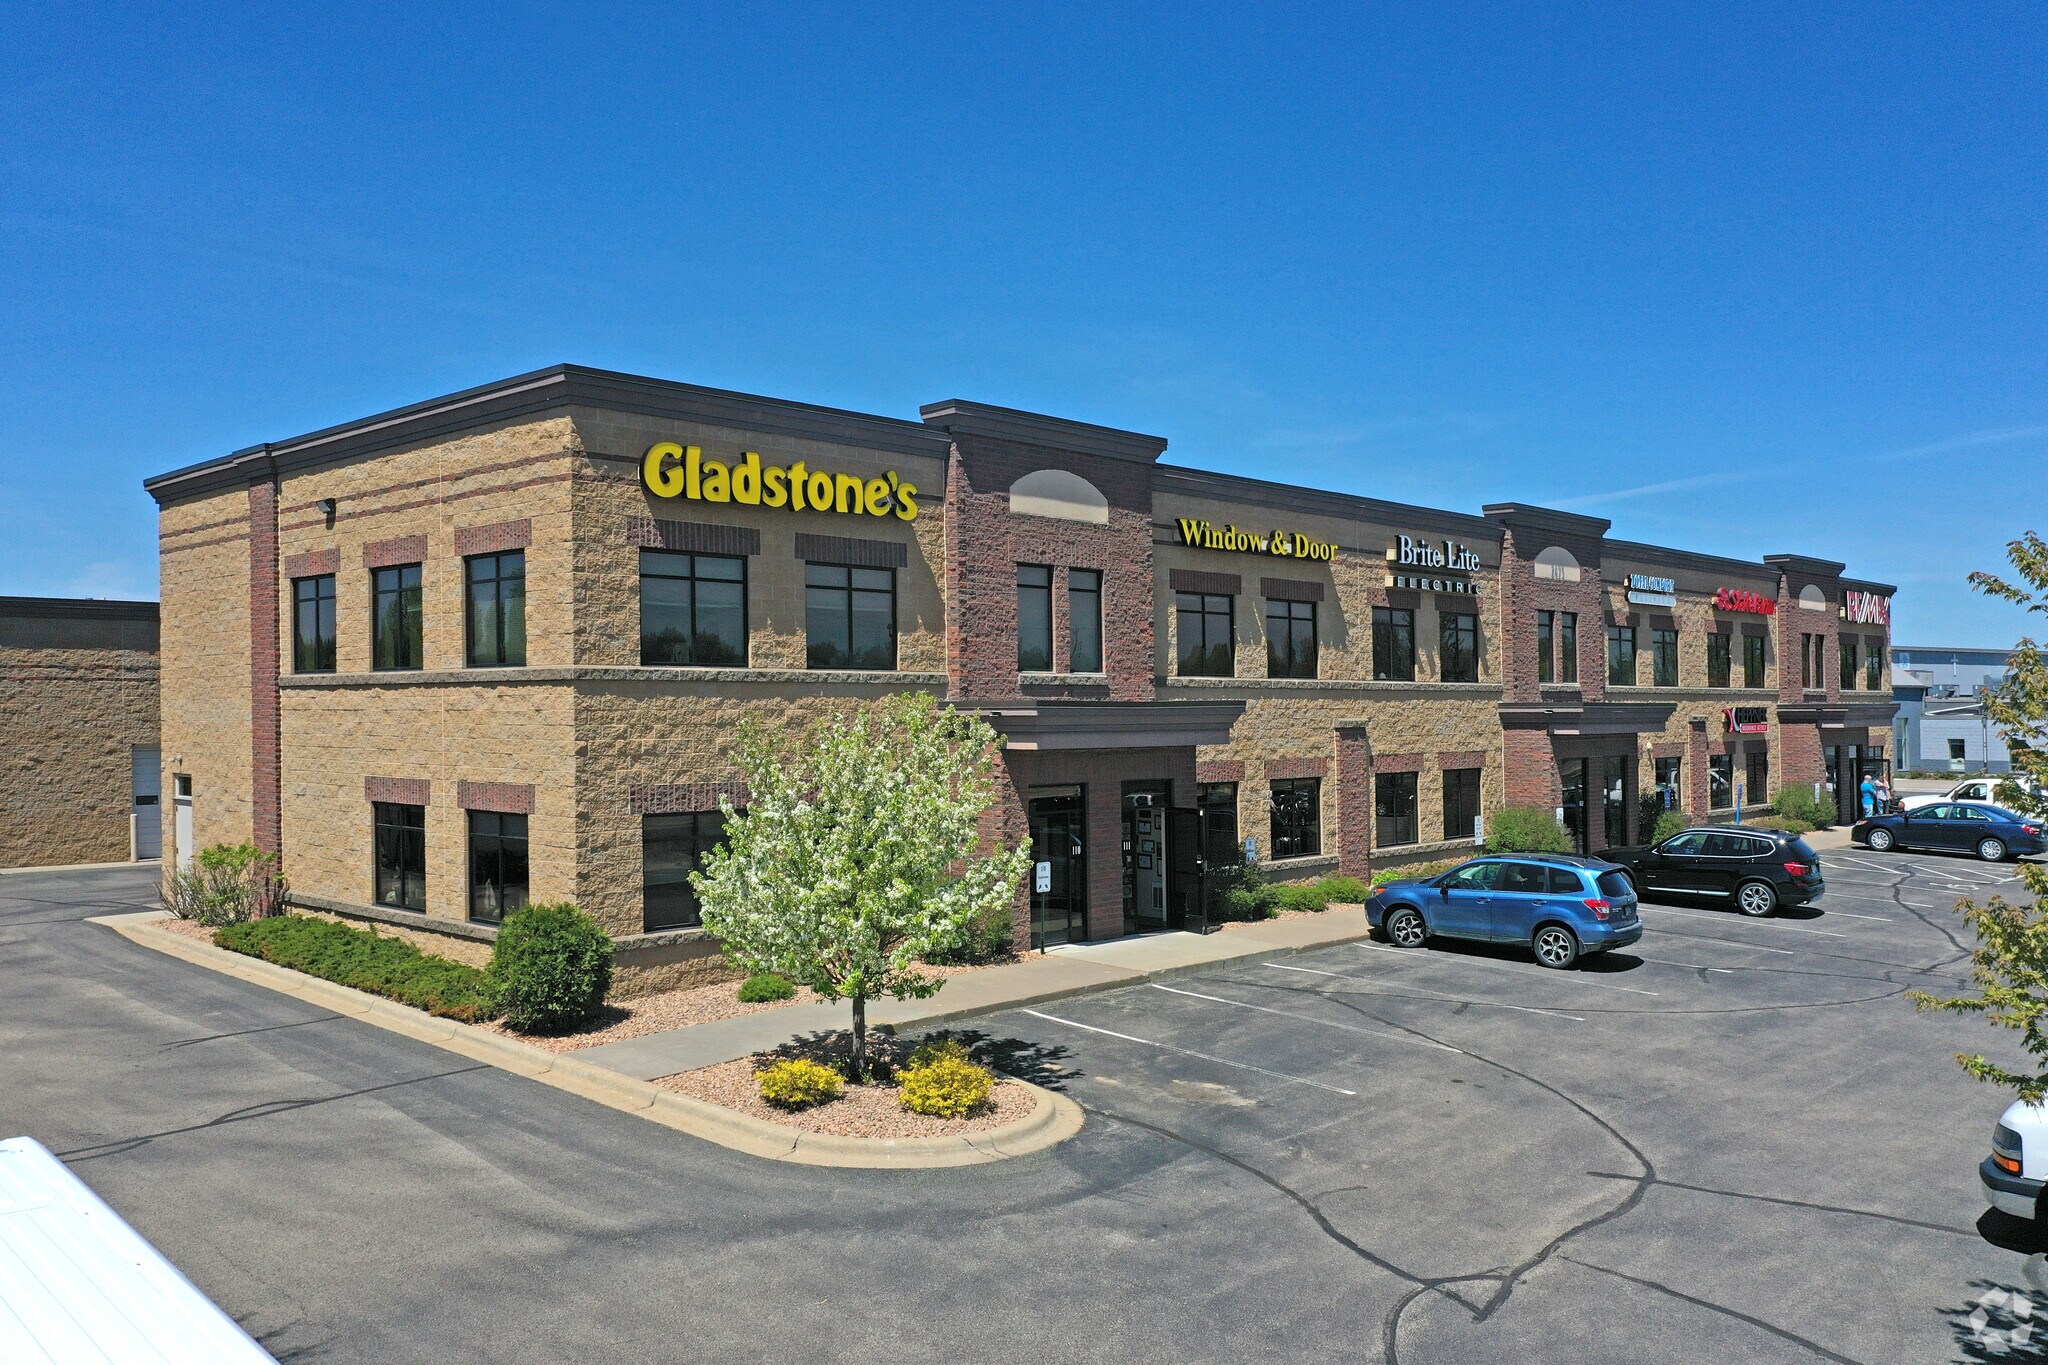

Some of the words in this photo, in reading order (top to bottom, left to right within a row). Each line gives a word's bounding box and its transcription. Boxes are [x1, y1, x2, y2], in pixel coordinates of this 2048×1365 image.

[642, 441, 918, 521] Gladstone's
[1177, 518, 1263, 552] Window
[1268, 529, 1287, 556] &
[1292, 532, 1338, 561] Door
[1397, 535, 1440, 568] Brite
[1443, 540, 1480, 571] Lite
[1396, 576, 1482, 595] ELECTRIC
[1072, 845, 1081, 855] 110
